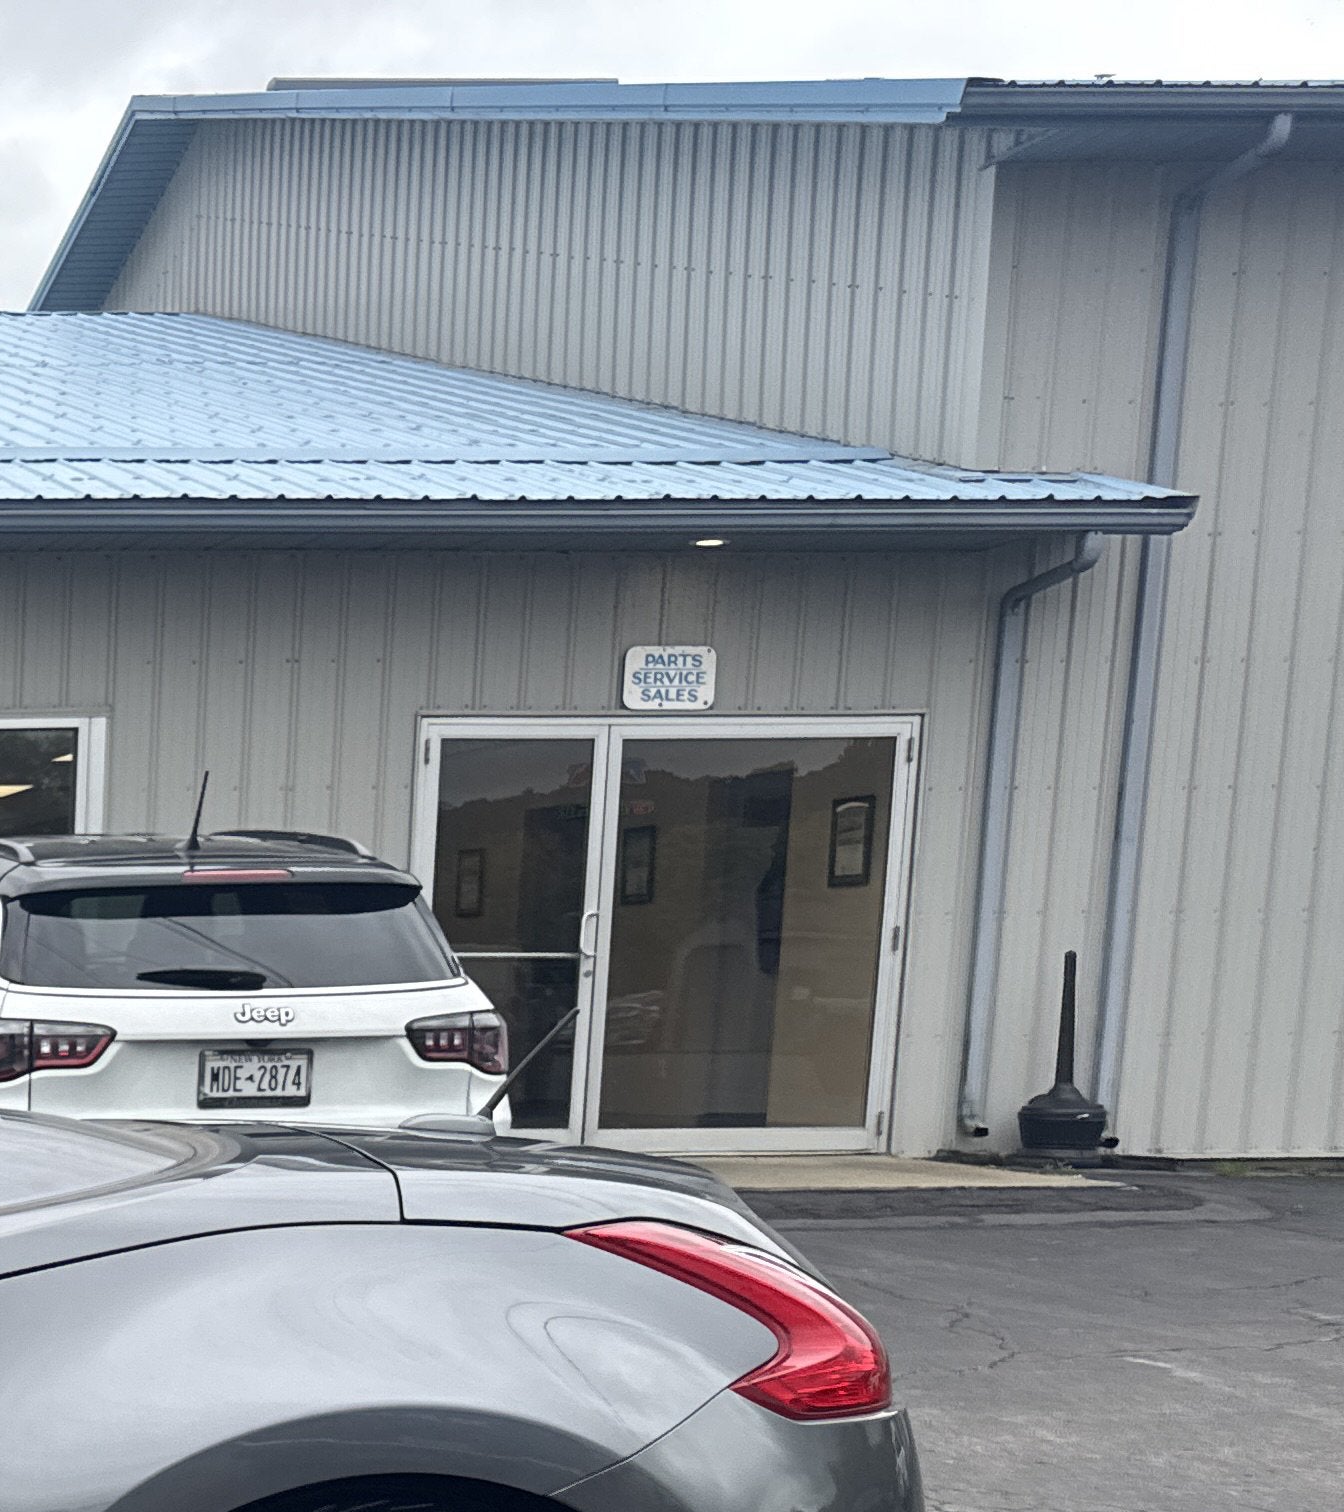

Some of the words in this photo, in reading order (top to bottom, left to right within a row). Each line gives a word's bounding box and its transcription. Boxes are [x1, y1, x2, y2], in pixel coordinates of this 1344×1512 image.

[644, 653, 703, 668] PARTS
[631, 671, 707, 686] SERVICE
[640, 688, 699, 703] SALES
[234, 1003, 295, 1027] Jeep
